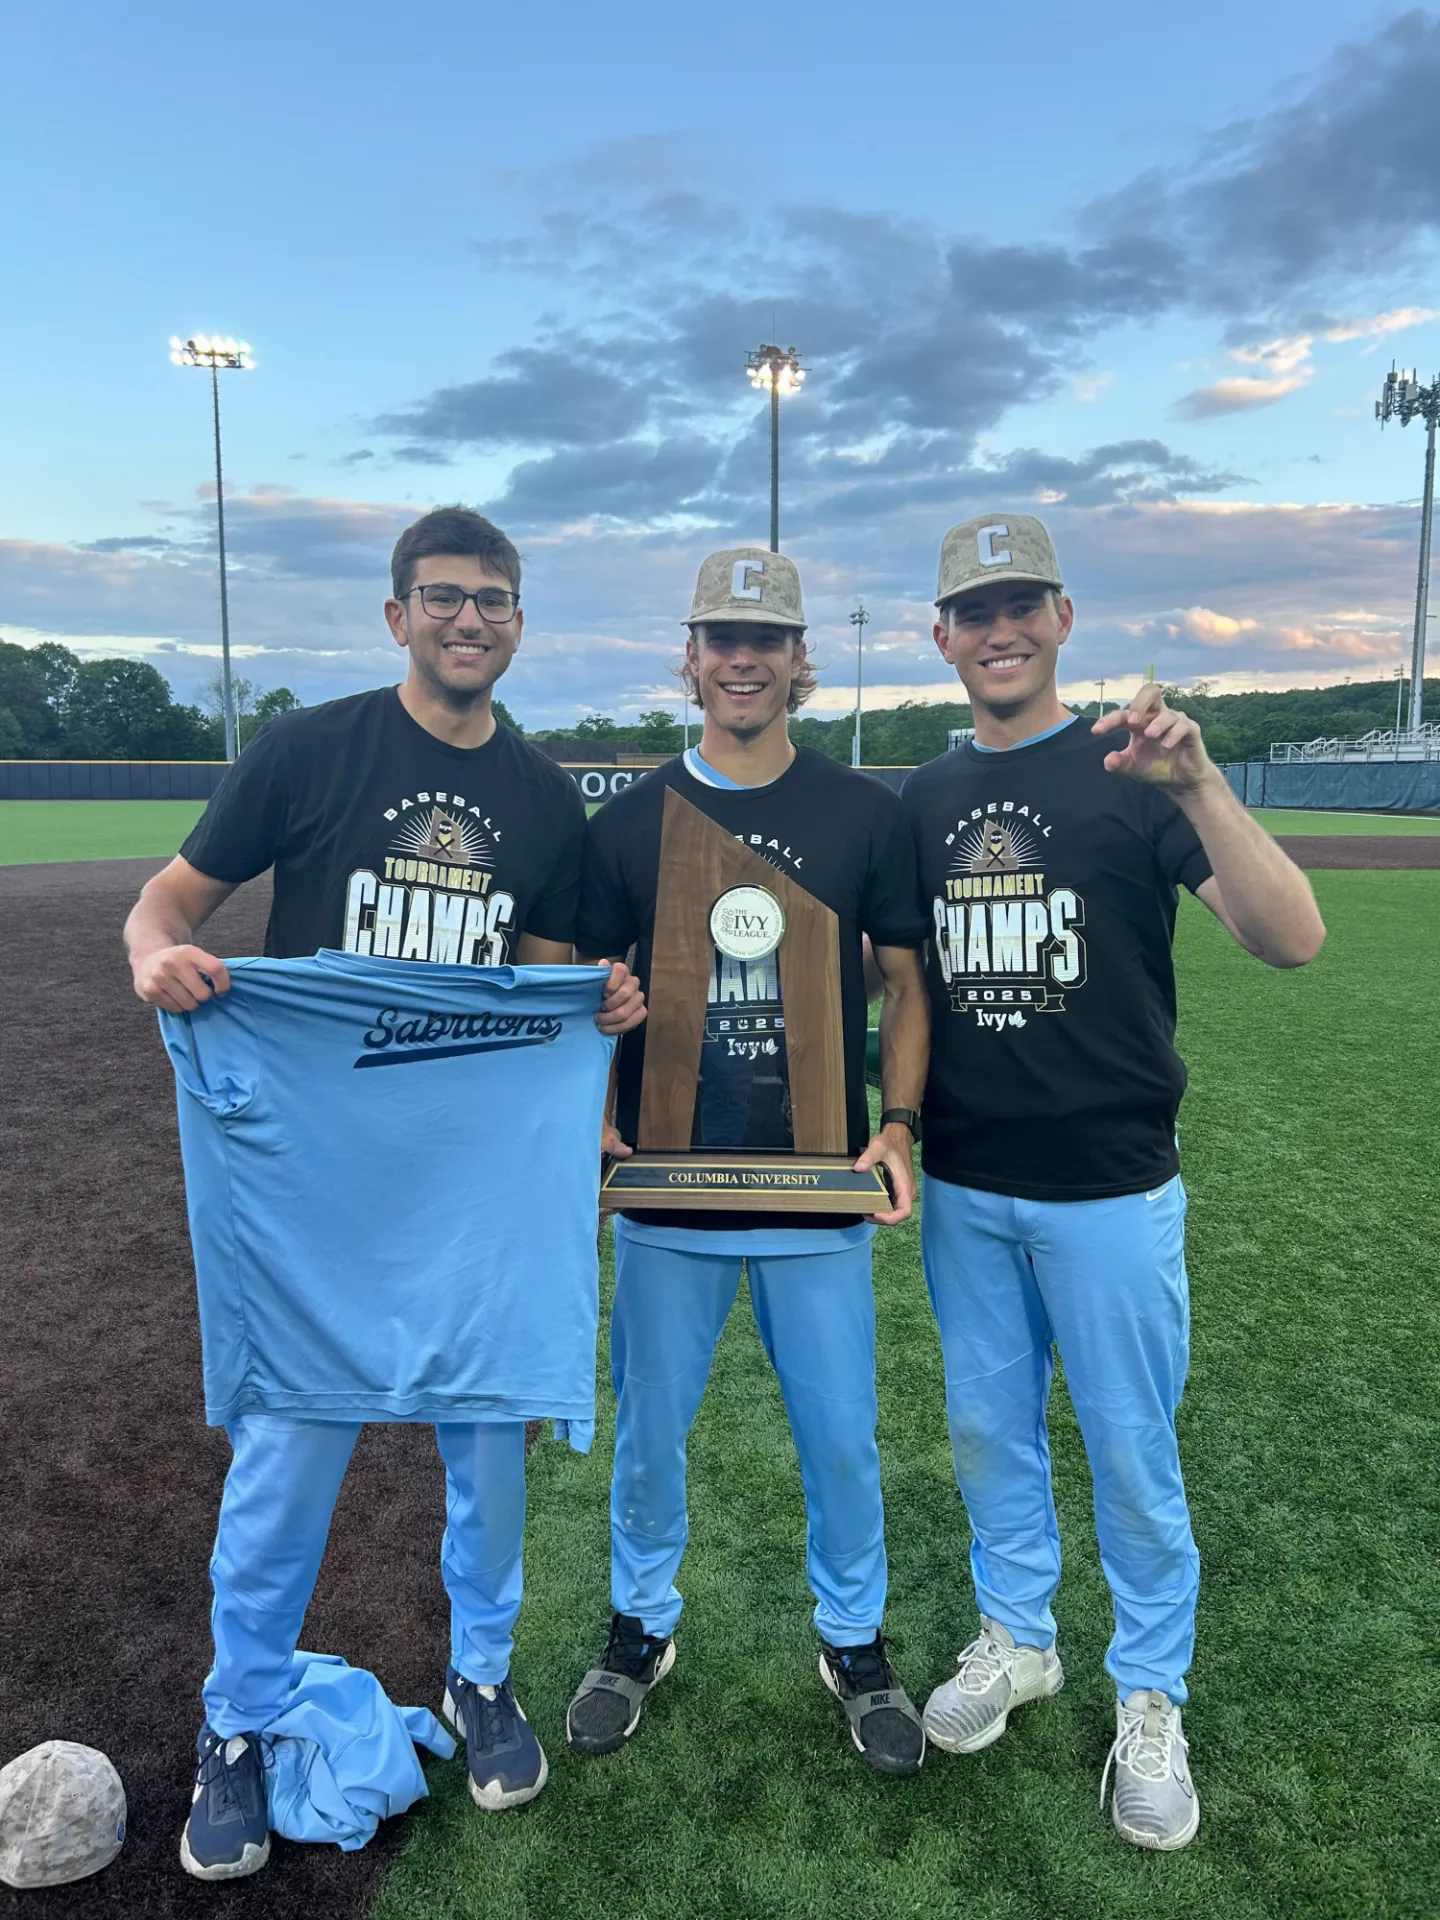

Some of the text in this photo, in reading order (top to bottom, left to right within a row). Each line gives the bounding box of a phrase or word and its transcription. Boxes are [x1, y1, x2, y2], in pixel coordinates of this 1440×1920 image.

[977, 524, 1012, 568] C
[731, 559, 765, 602] C
[383, 791, 502, 842] BASEBALL
[945, 801, 1052, 845] BASEBALL
[384, 856, 492, 894] TOURNAMENT
[945, 874, 1044, 900] TOURNAMENT
[344, 869, 515, 966] CHAMPS
[734, 915, 769, 930] IVY
[934, 887, 1087, 990] CHAMPS
[967, 990, 1032, 1001] 2025
[976, 1008, 1007, 1032] Ivy
[727, 1038, 760, 1060] Ivy
[668, 1172, 820, 1186] COLUMBIA UNIVERSITY
[870, 1692, 891, 1707] NIKE
